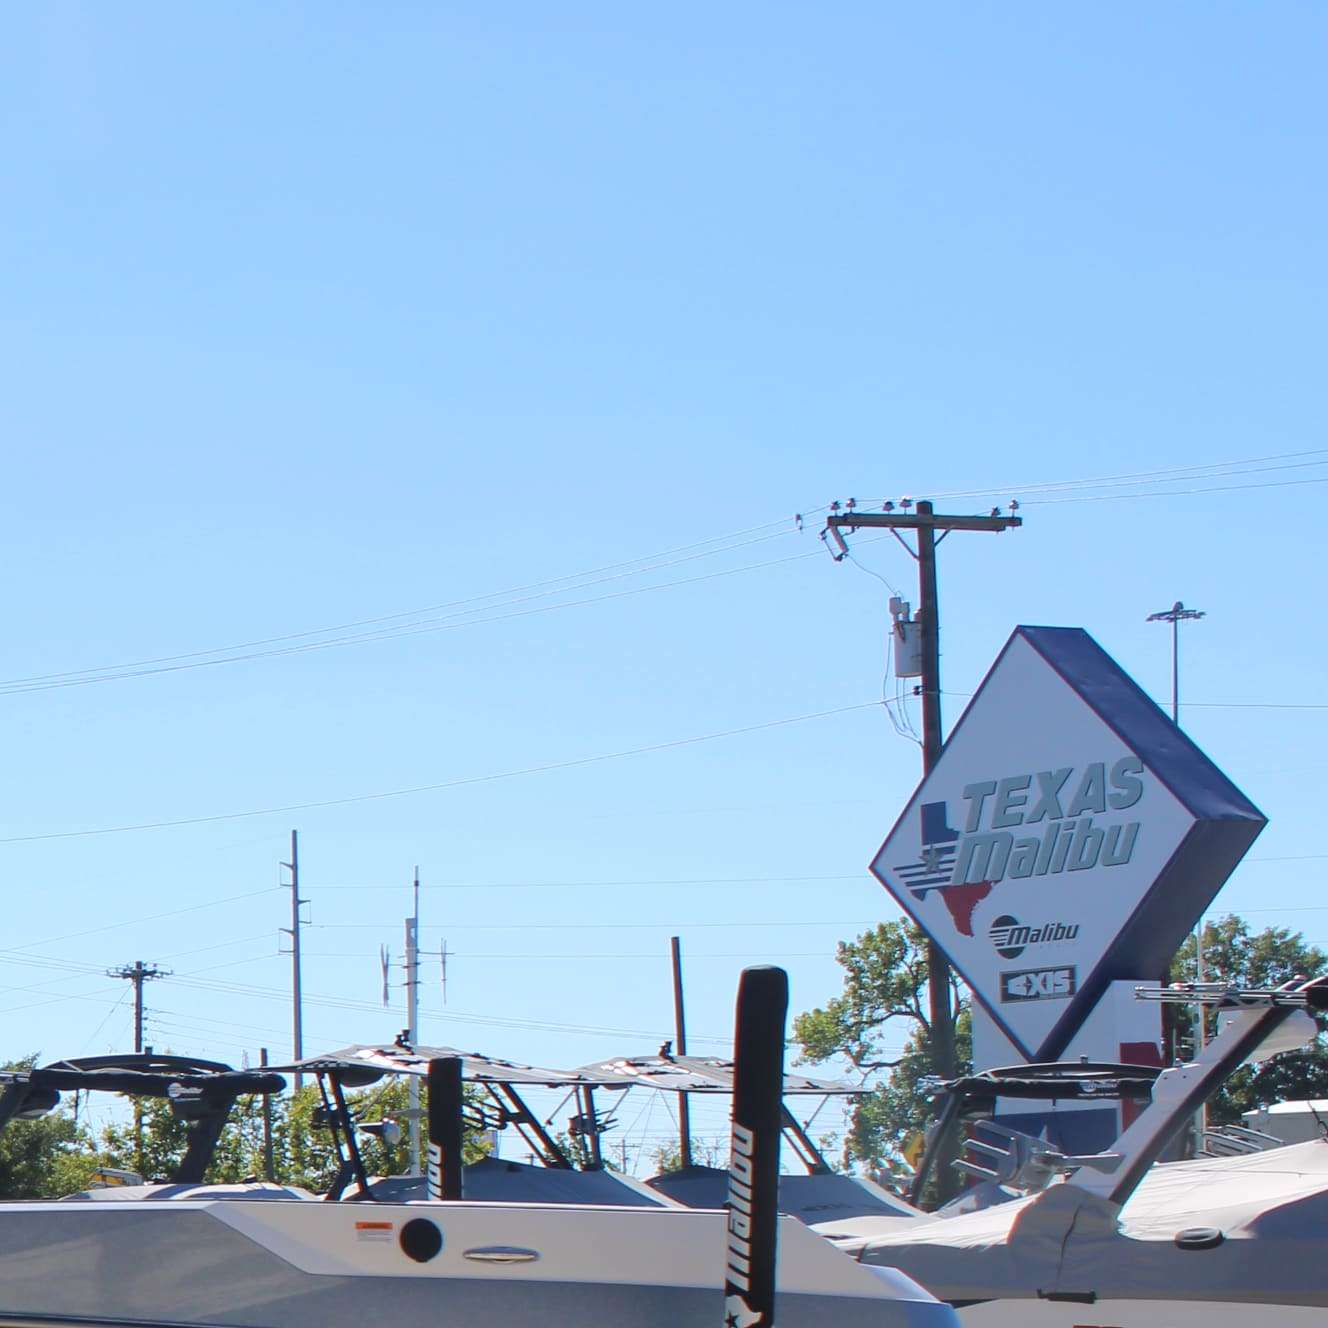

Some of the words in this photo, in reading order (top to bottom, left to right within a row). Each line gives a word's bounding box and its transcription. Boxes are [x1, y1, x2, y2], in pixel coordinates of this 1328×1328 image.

[962, 756, 1144, 833] TEXAS
[950, 818, 1141, 885] Malibu
[1007, 922, 1080, 946] Malibu
[1007, 969, 1072, 998] AXIS
[726, 1122, 754, 1293] Malibu
